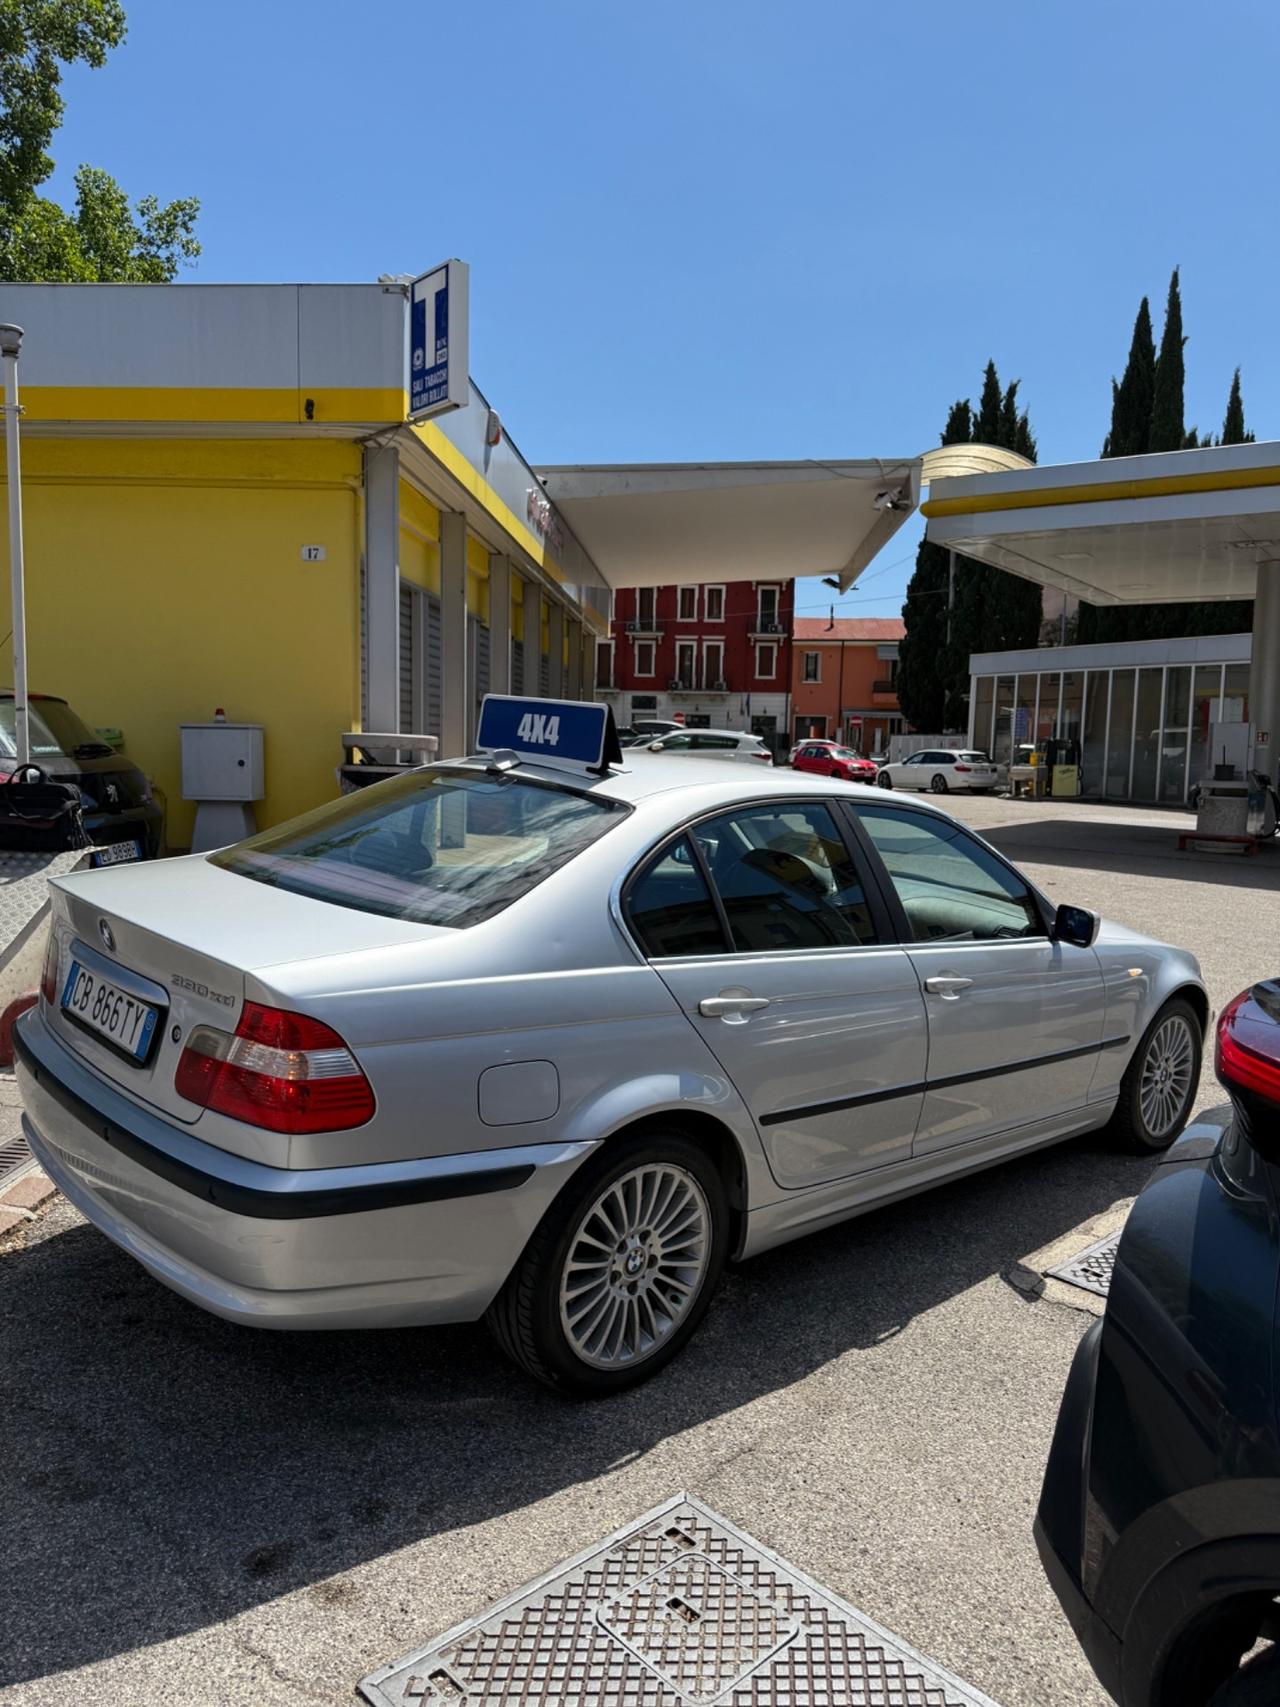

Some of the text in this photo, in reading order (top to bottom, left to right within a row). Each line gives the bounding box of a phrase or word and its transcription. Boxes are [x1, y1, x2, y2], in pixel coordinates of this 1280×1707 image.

[414, 268, 446, 370] T
[308, 547, 320, 559] 17
[517, 713, 560, 746] 4X4
[72, 971, 145, 1046] CB 866TY
